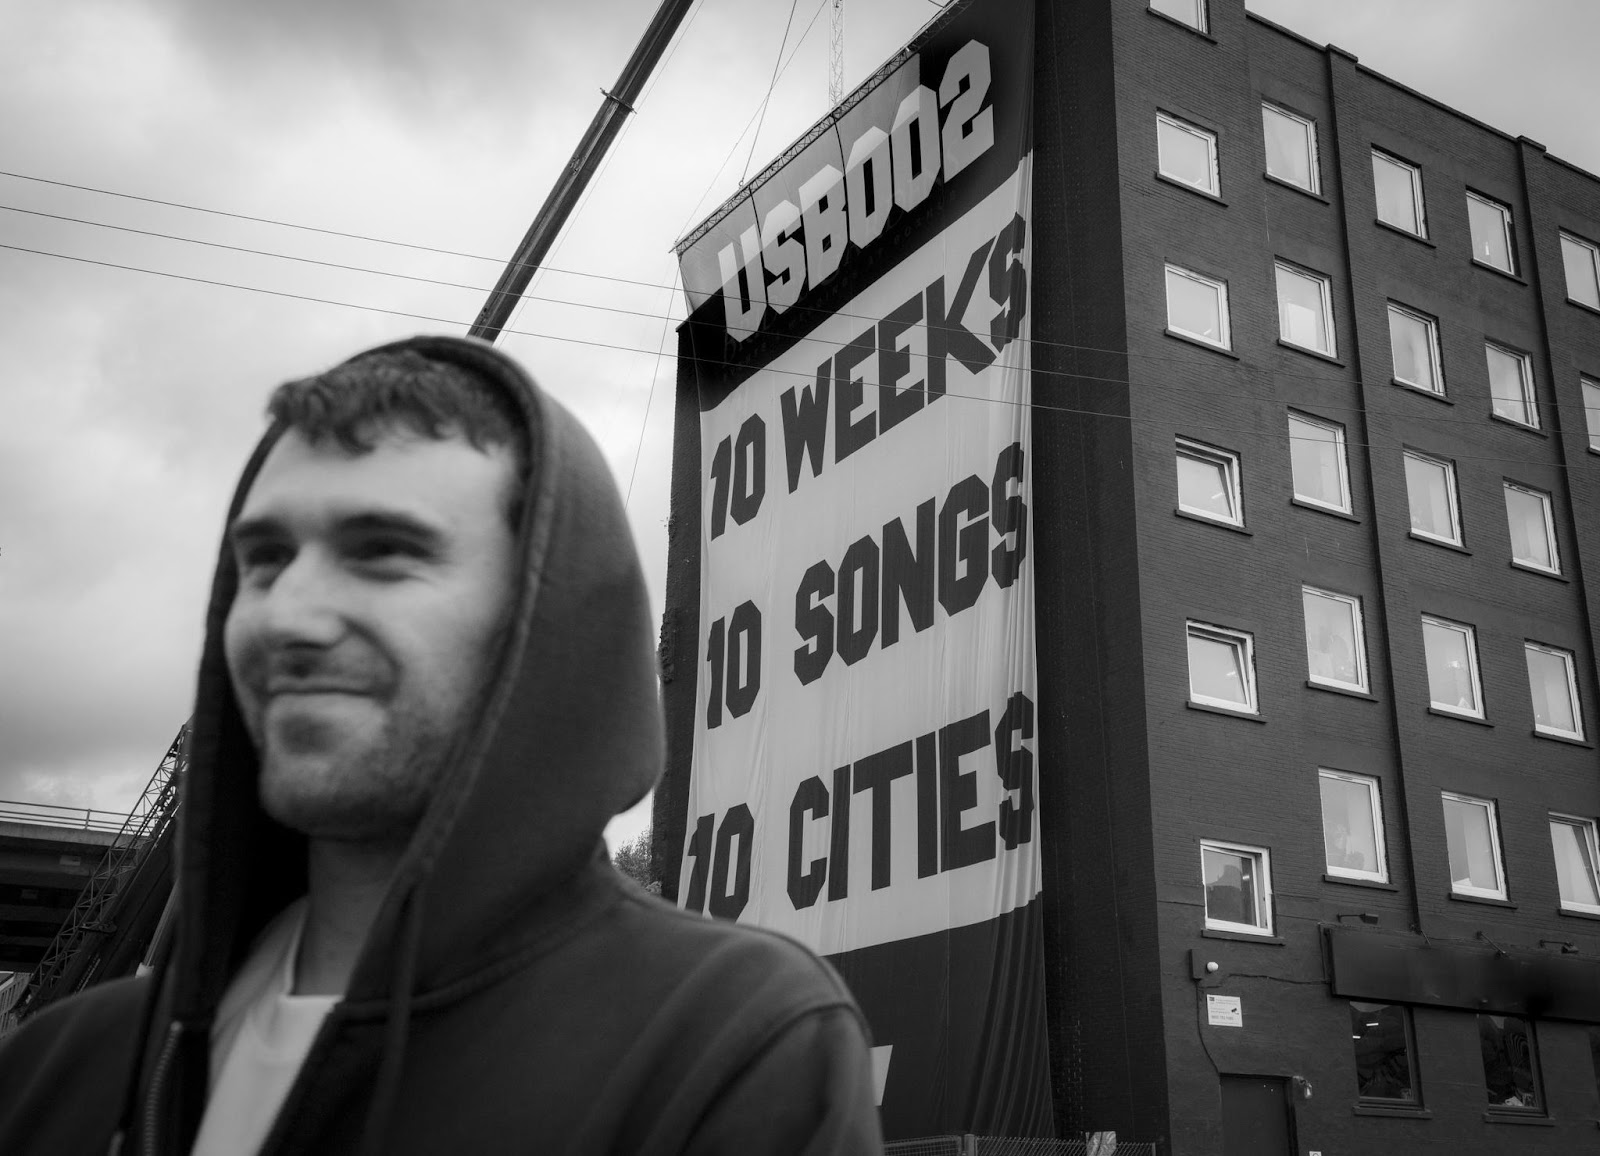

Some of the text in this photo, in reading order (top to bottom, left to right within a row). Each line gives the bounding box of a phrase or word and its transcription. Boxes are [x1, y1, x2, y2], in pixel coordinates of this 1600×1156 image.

[718, 39, 994, 343] USB002
[710, 413, 766, 541] 10
[780, 211, 1027, 494] WEEKS
[706, 441, 1027, 729] 10 SONGS
[684, 691, 1034, 924] 10 CITIES
